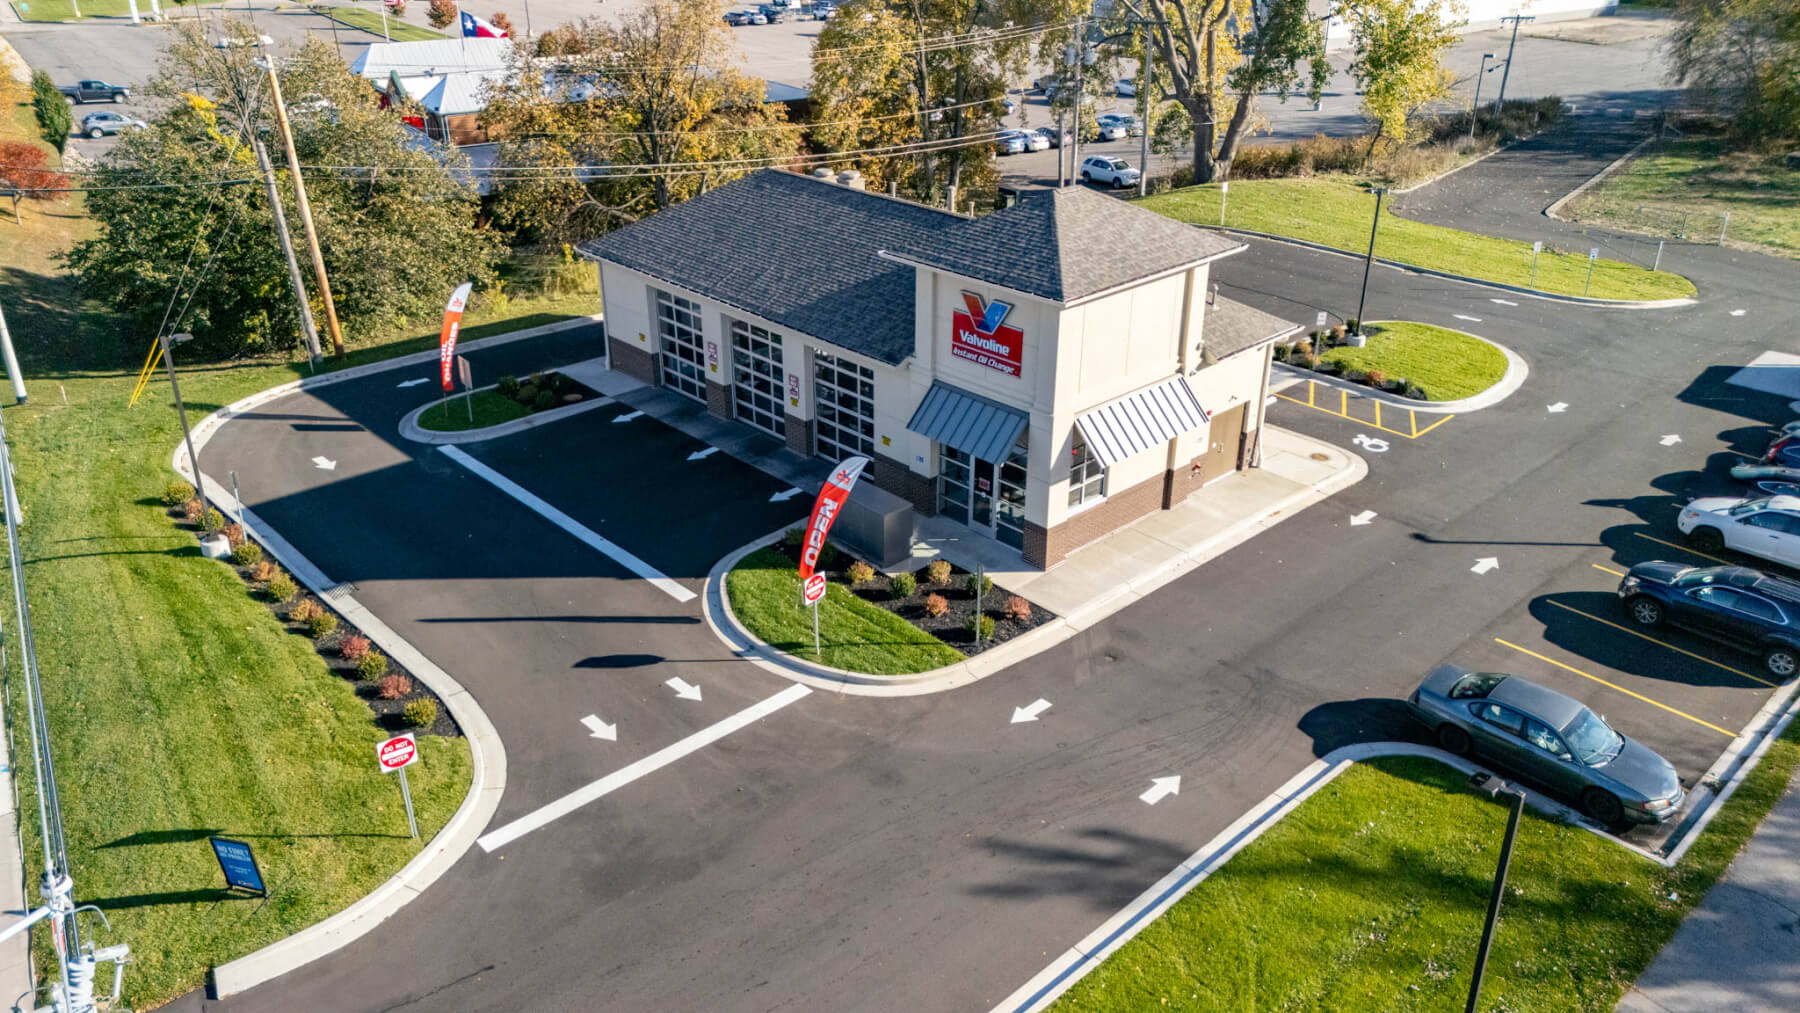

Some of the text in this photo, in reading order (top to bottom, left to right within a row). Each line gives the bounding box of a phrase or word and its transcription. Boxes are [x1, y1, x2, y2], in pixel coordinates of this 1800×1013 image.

[959, 329, 1010, 357] Valvoline
[953, 347, 1015, 374] Instant Oil Change
[804, 498, 838, 566] OPEN
[384, 739, 408, 753] DO NOT
[388, 753, 409, 765] ENTER
